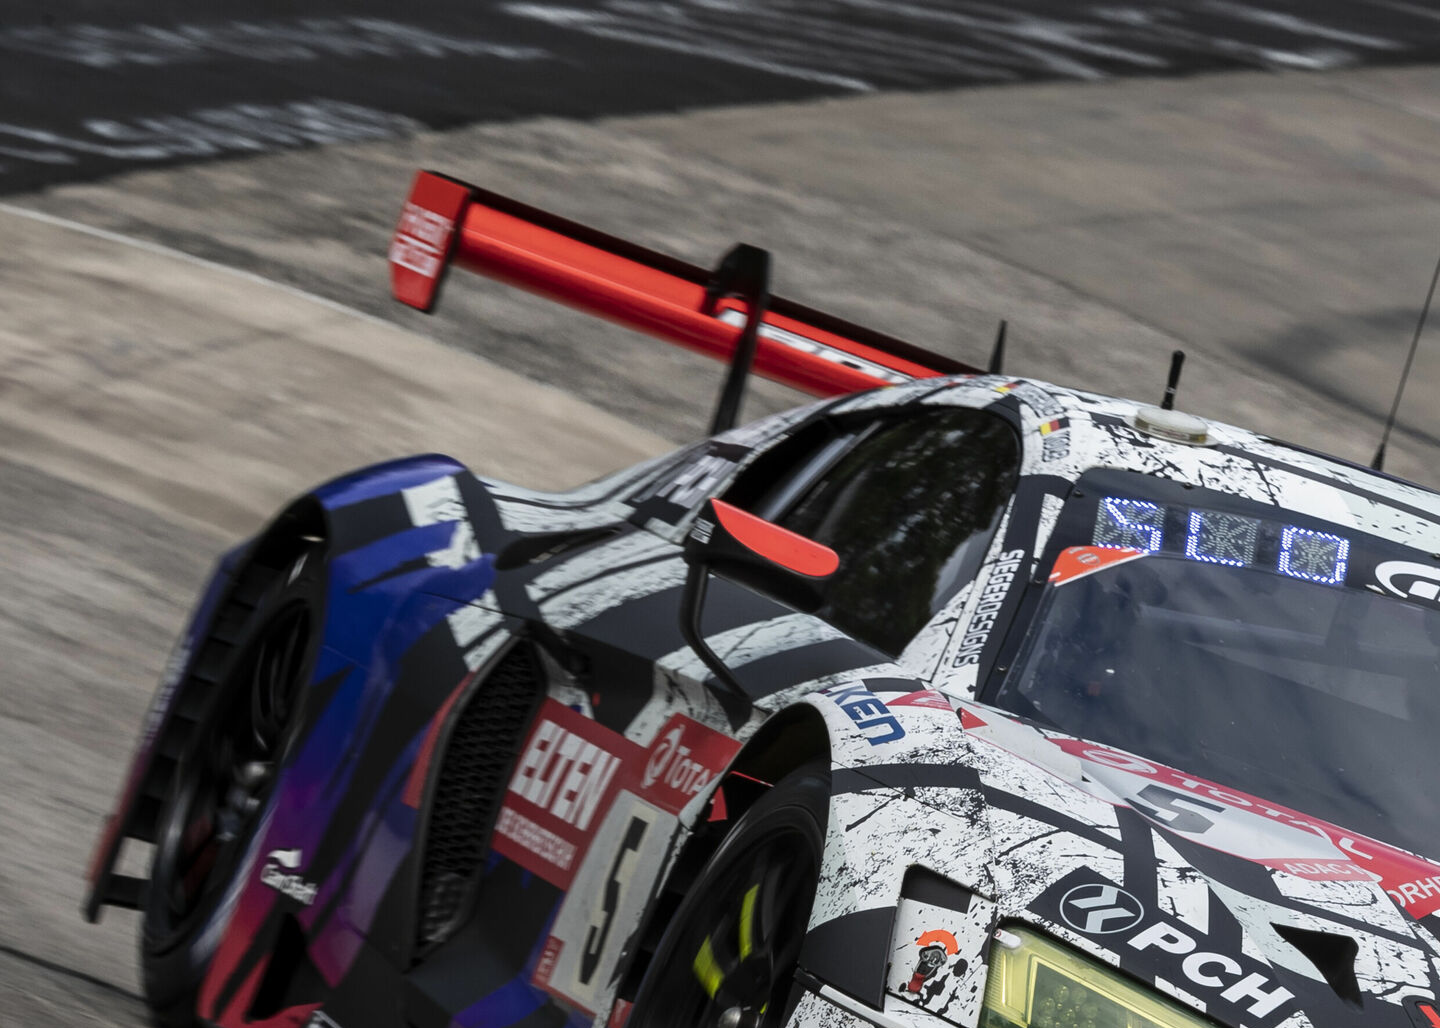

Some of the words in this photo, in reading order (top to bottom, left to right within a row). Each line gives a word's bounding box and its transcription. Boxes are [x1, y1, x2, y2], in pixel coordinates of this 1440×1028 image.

[952, 549, 1025, 668] SIEGERDESIGNS
[508, 719, 623, 831] ELTEN
[664, 744, 720, 796] TOTA
[579, 816, 648, 986] 5
[1127, 921, 1296, 1019] PCH
